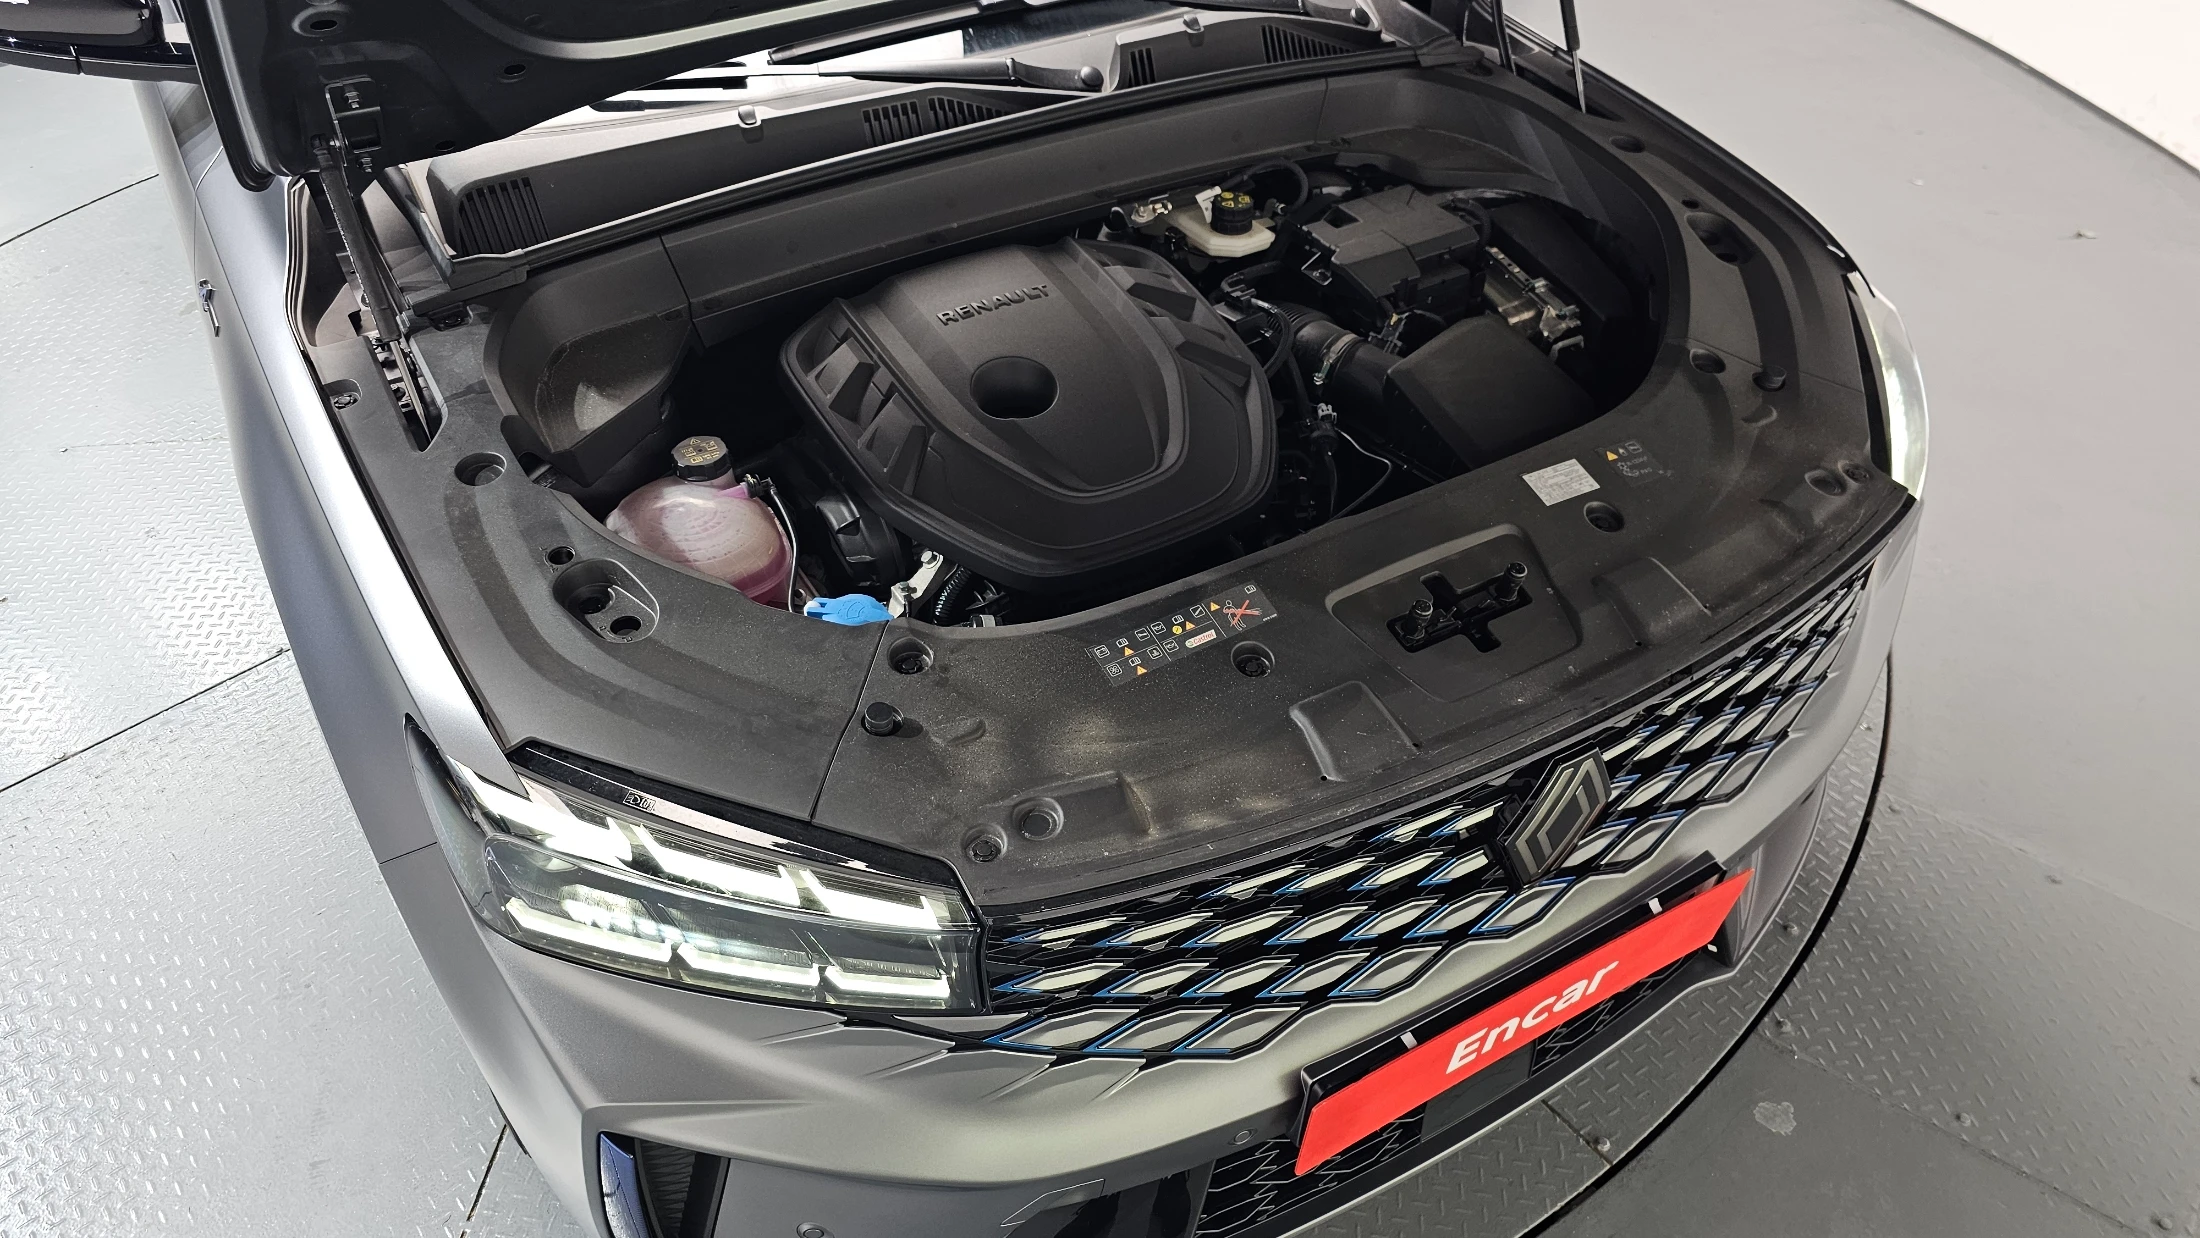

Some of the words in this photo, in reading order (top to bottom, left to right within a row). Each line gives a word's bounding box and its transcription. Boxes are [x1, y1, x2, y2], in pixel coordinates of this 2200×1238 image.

[936, 284, 1048, 326] RENAULT
[1193, 631, 1214, 645] Castrol
[1446, 961, 1619, 1074] Encar
